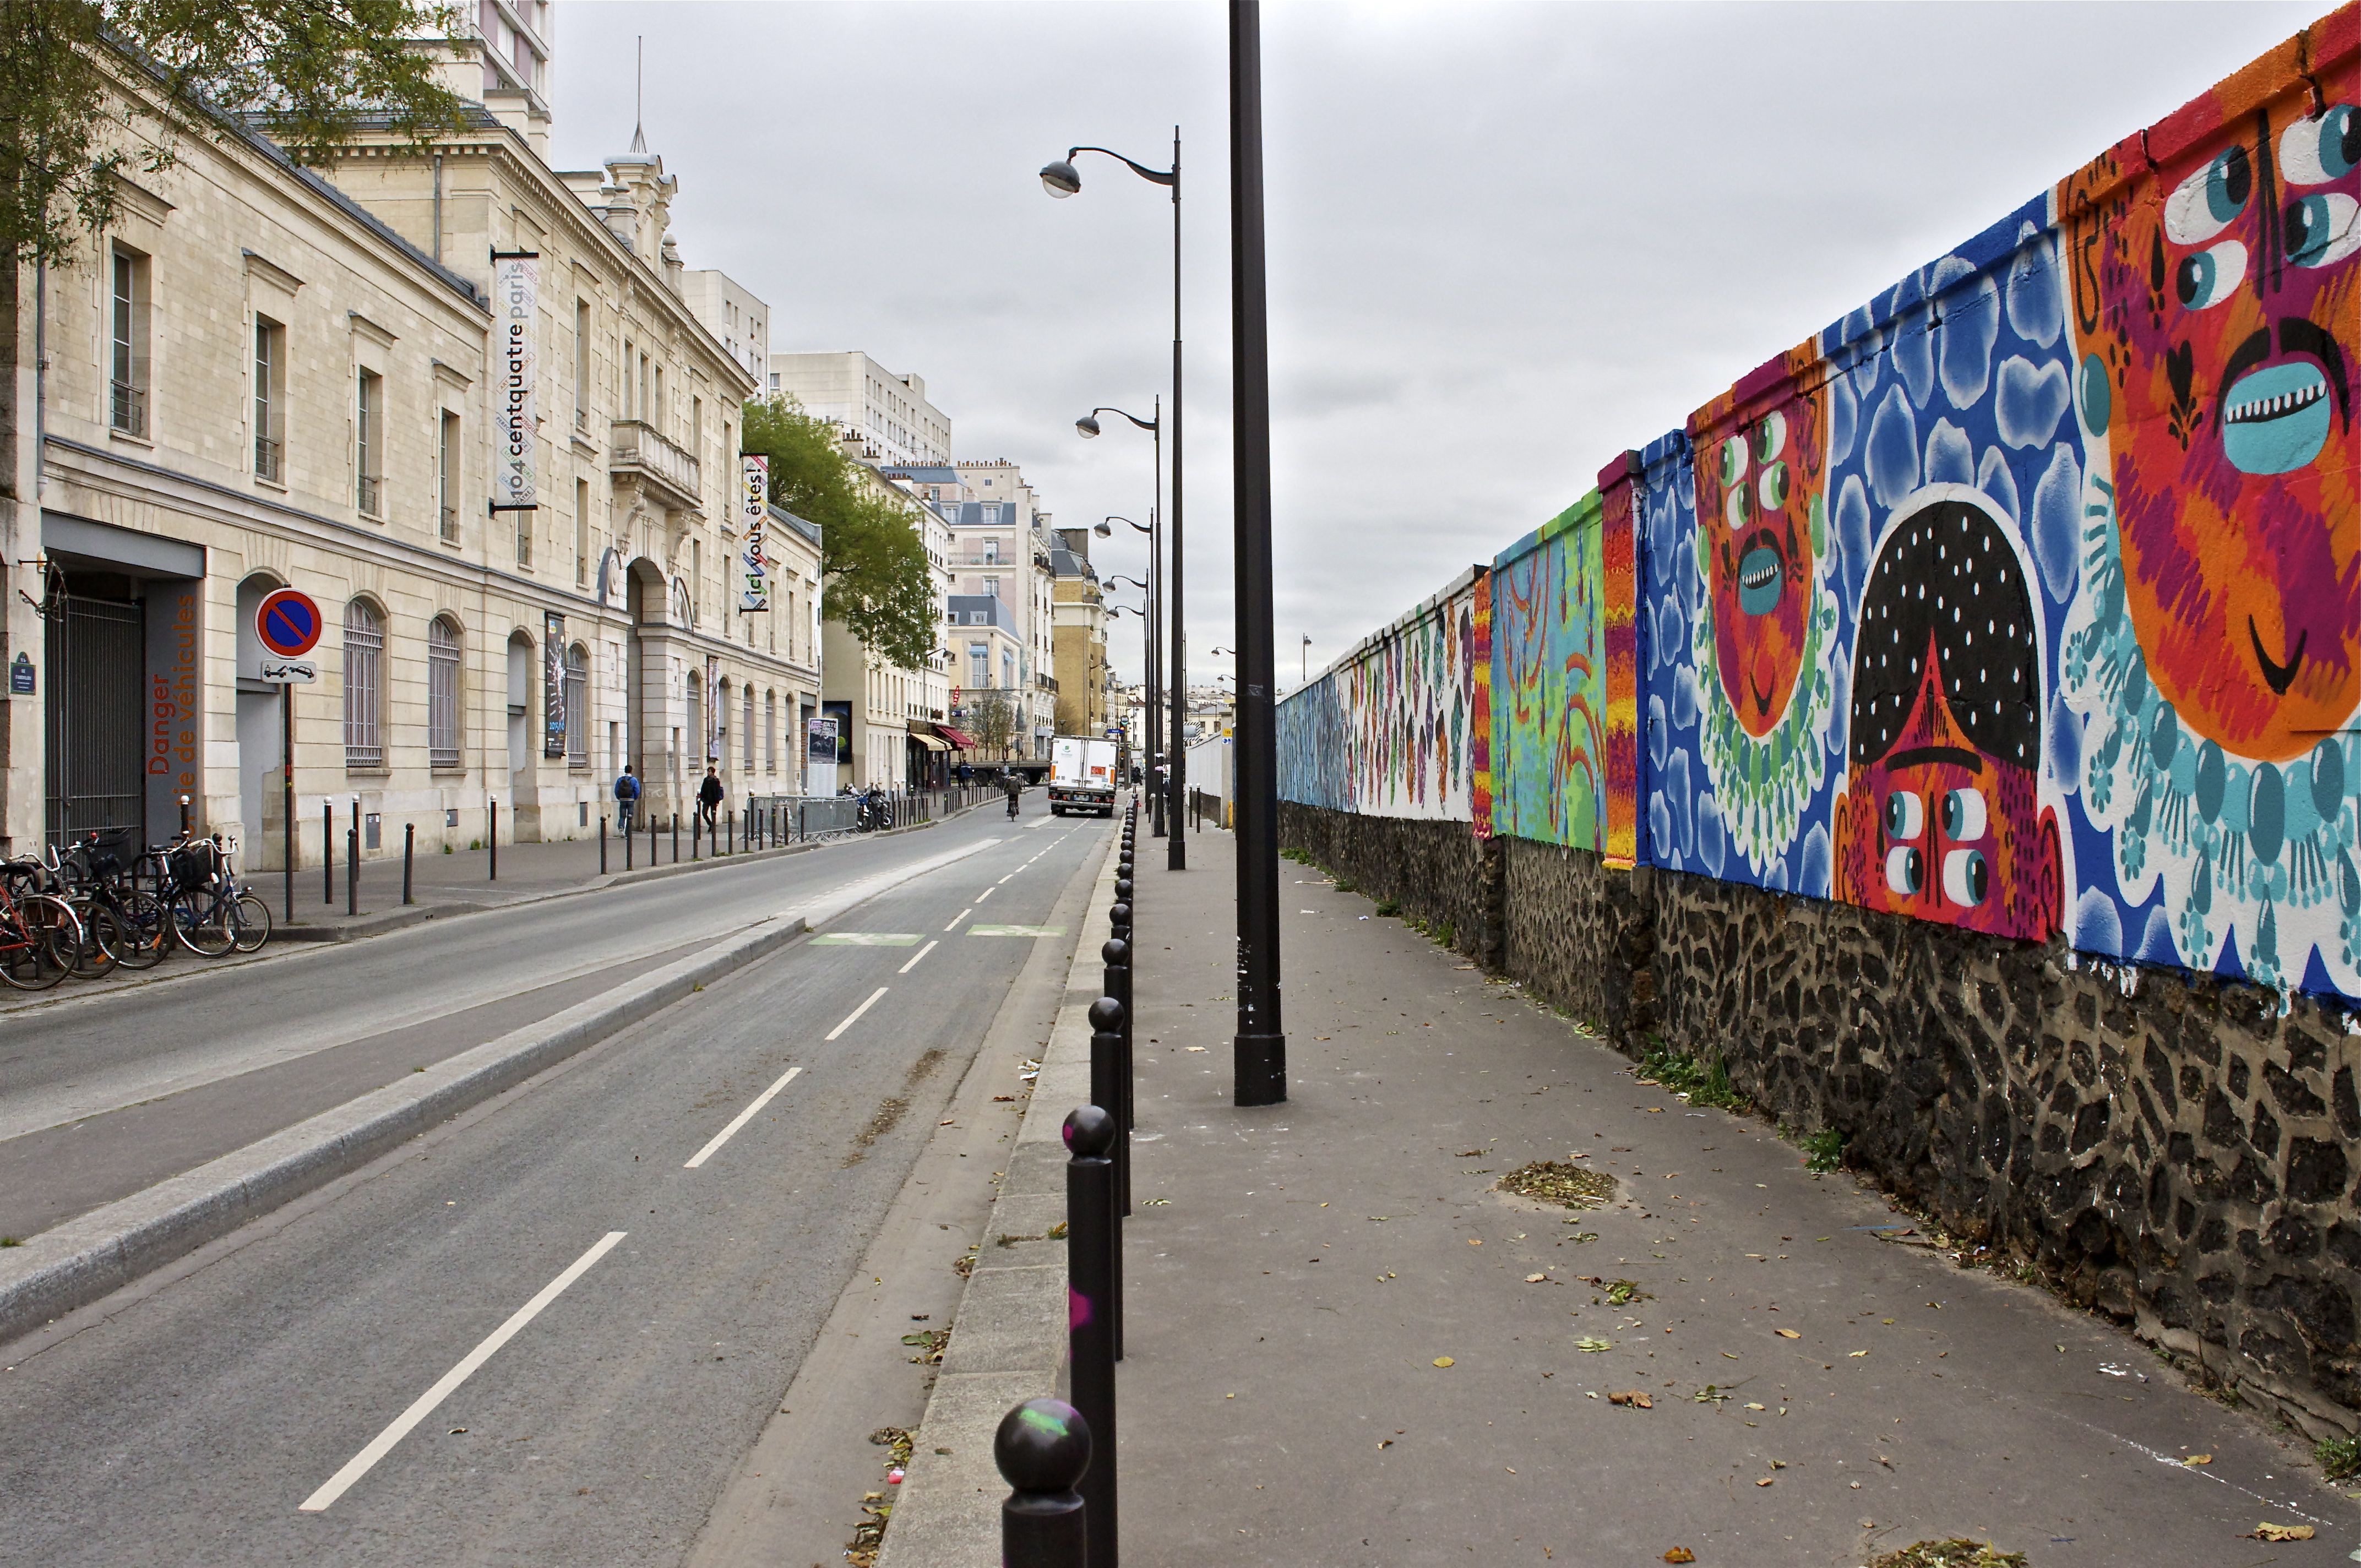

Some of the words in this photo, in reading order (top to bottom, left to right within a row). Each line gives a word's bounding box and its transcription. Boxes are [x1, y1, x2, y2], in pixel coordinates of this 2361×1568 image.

[499, 269, 513, 285] MAIE
[505, 263, 529, 319] paris
[521, 264, 537, 282] ISUELS
[506, 324, 527, 456] centquatre
[510, 460, 526, 498] 104
[746, 468, 761, 515] êtes!
[750, 523, 761, 567] vous
[746, 573, 761, 595] ici
[172, 595, 195, 722] véhicules
[148, 673, 176, 775] Danger
[173, 730, 195, 763] de
[172, 772, 195, 850] otie
